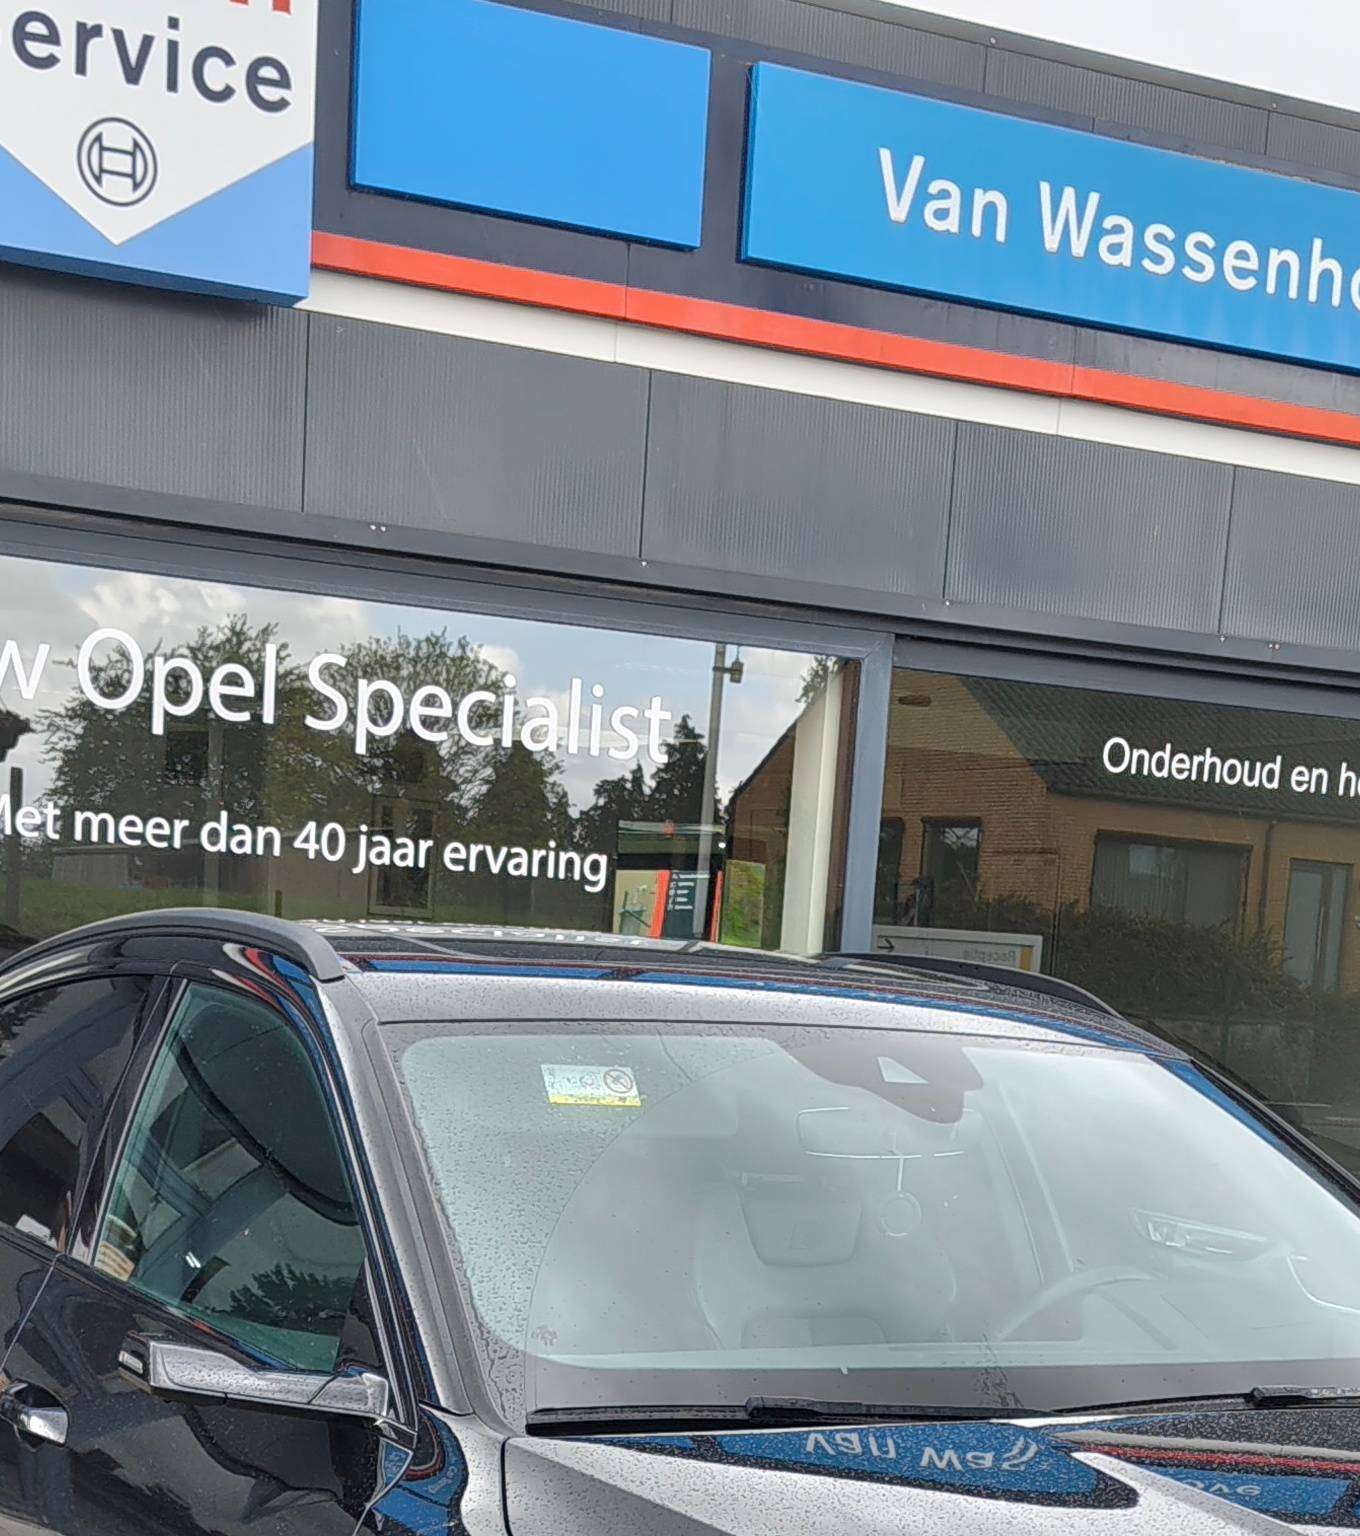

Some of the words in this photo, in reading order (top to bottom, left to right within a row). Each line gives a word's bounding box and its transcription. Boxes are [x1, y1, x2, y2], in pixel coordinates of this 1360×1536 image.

[879, 147, 1008, 243] Van
[77, 627, 277, 735] Opel
[305, 652, 673, 764] Specialist
[1102, 736, 1282, 790] Onderhoud
[1290, 763, 1328, 794] en
[72, 812, 189, 851] meer
[201, 809, 282, 858] dan
[292, 821, 346, 862] 40
[352, 824, 433, 874] jaar
[443, 840, 608, 892] ervaring
